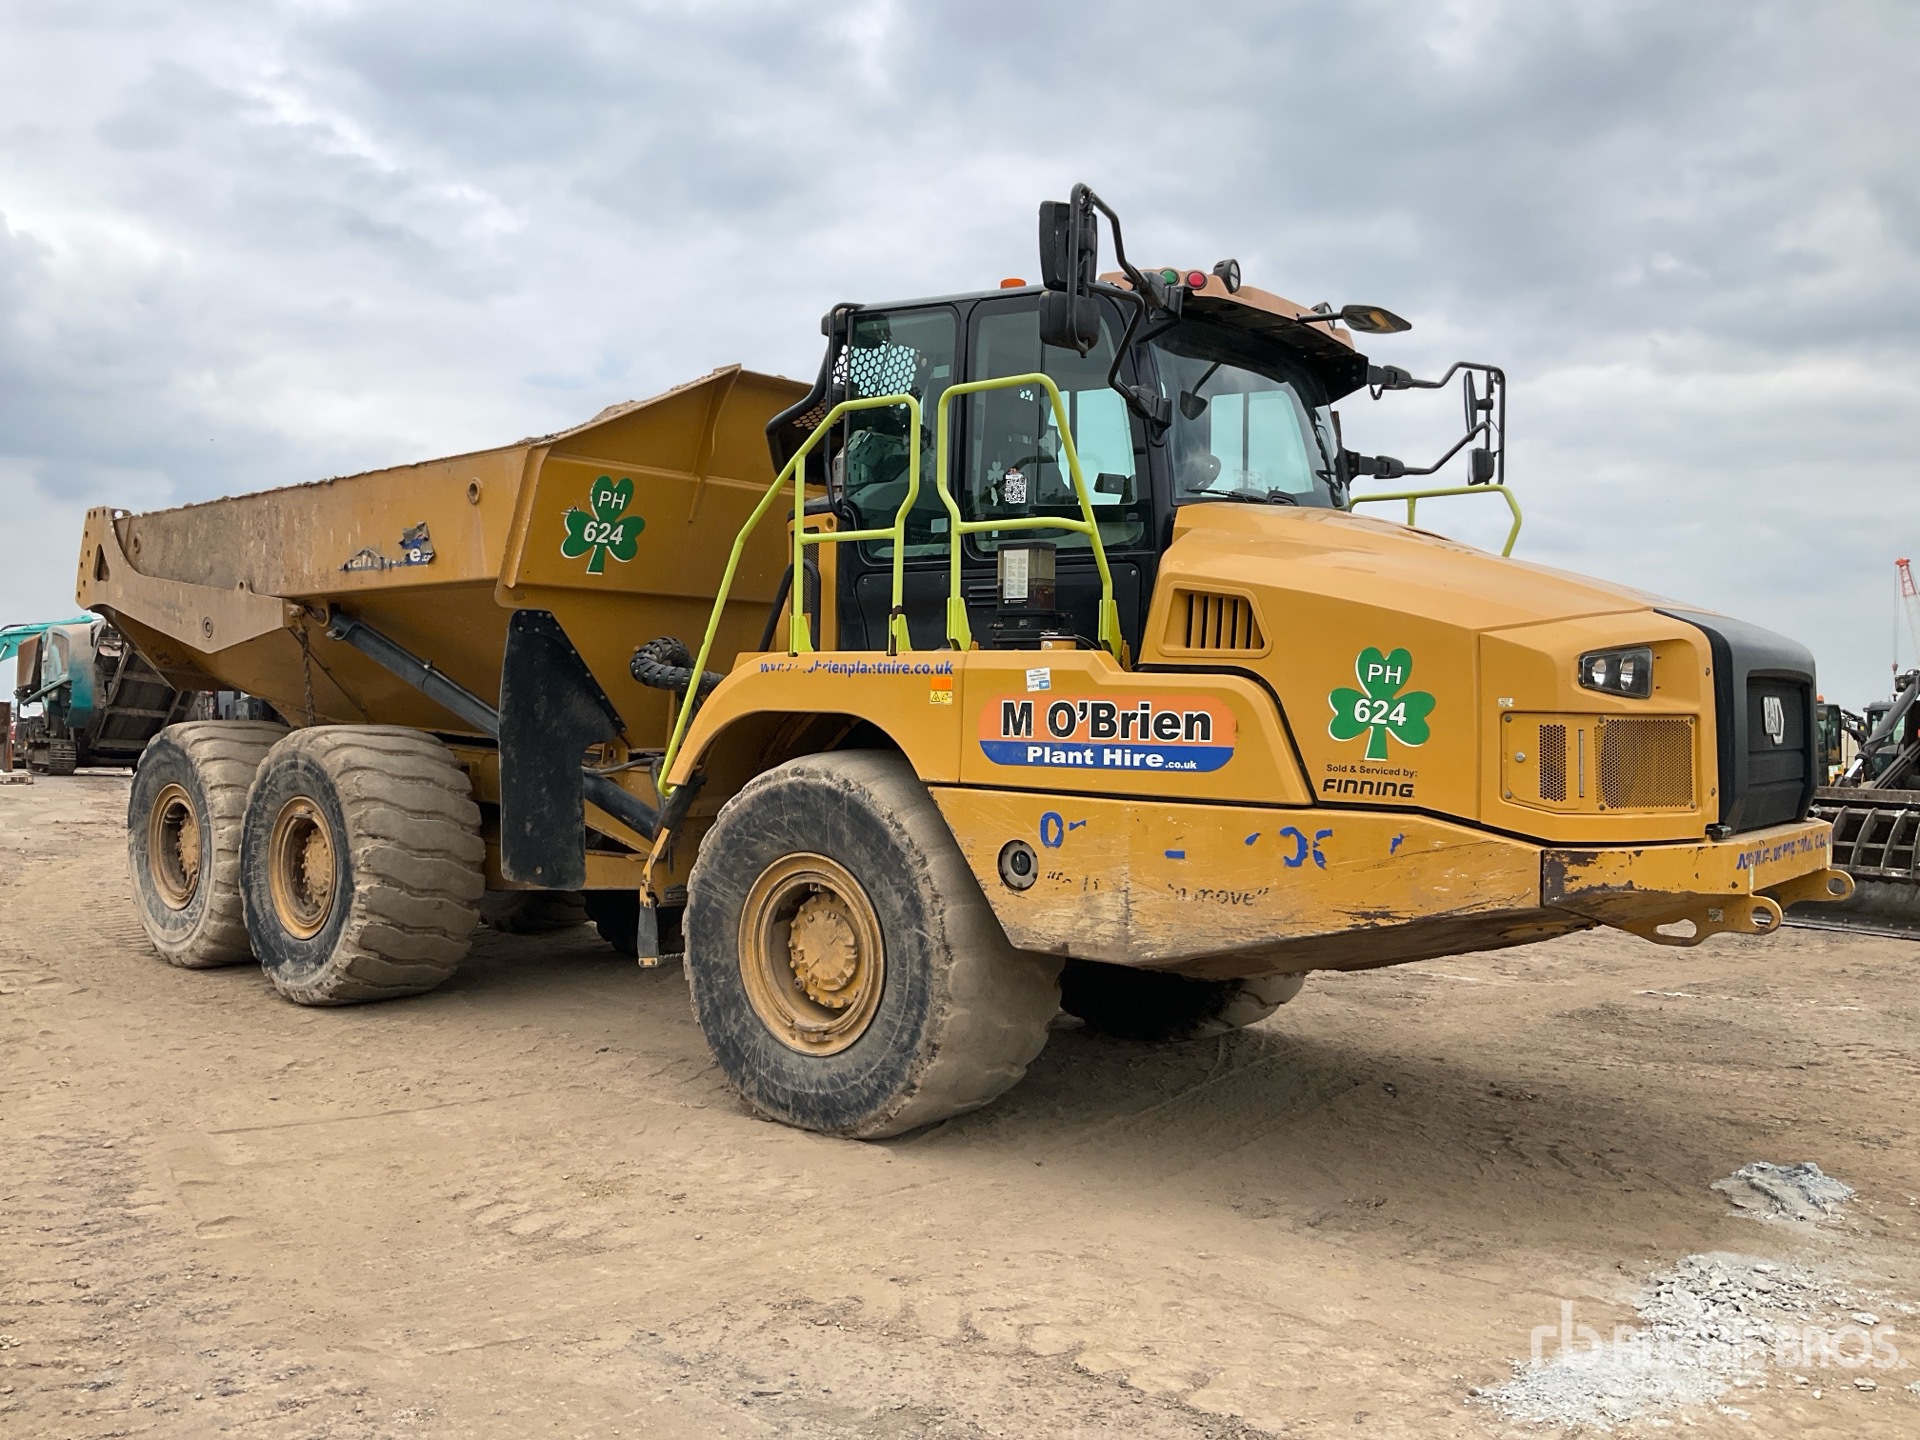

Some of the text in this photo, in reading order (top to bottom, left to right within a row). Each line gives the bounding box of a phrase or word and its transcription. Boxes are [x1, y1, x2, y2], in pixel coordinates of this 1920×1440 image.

[598, 490, 626, 510] PH
[583, 521, 625, 545] 624
[1367, 663, 1402, 685] PH
[1001, 700, 1034, 738] M
[1354, 698, 1407, 727] 624
[1026, 746, 1095, 767] Plant
[1326, 763, 1418, 779] Sold & Serviced by:
[1322, 778, 1415, 798] FINNING
